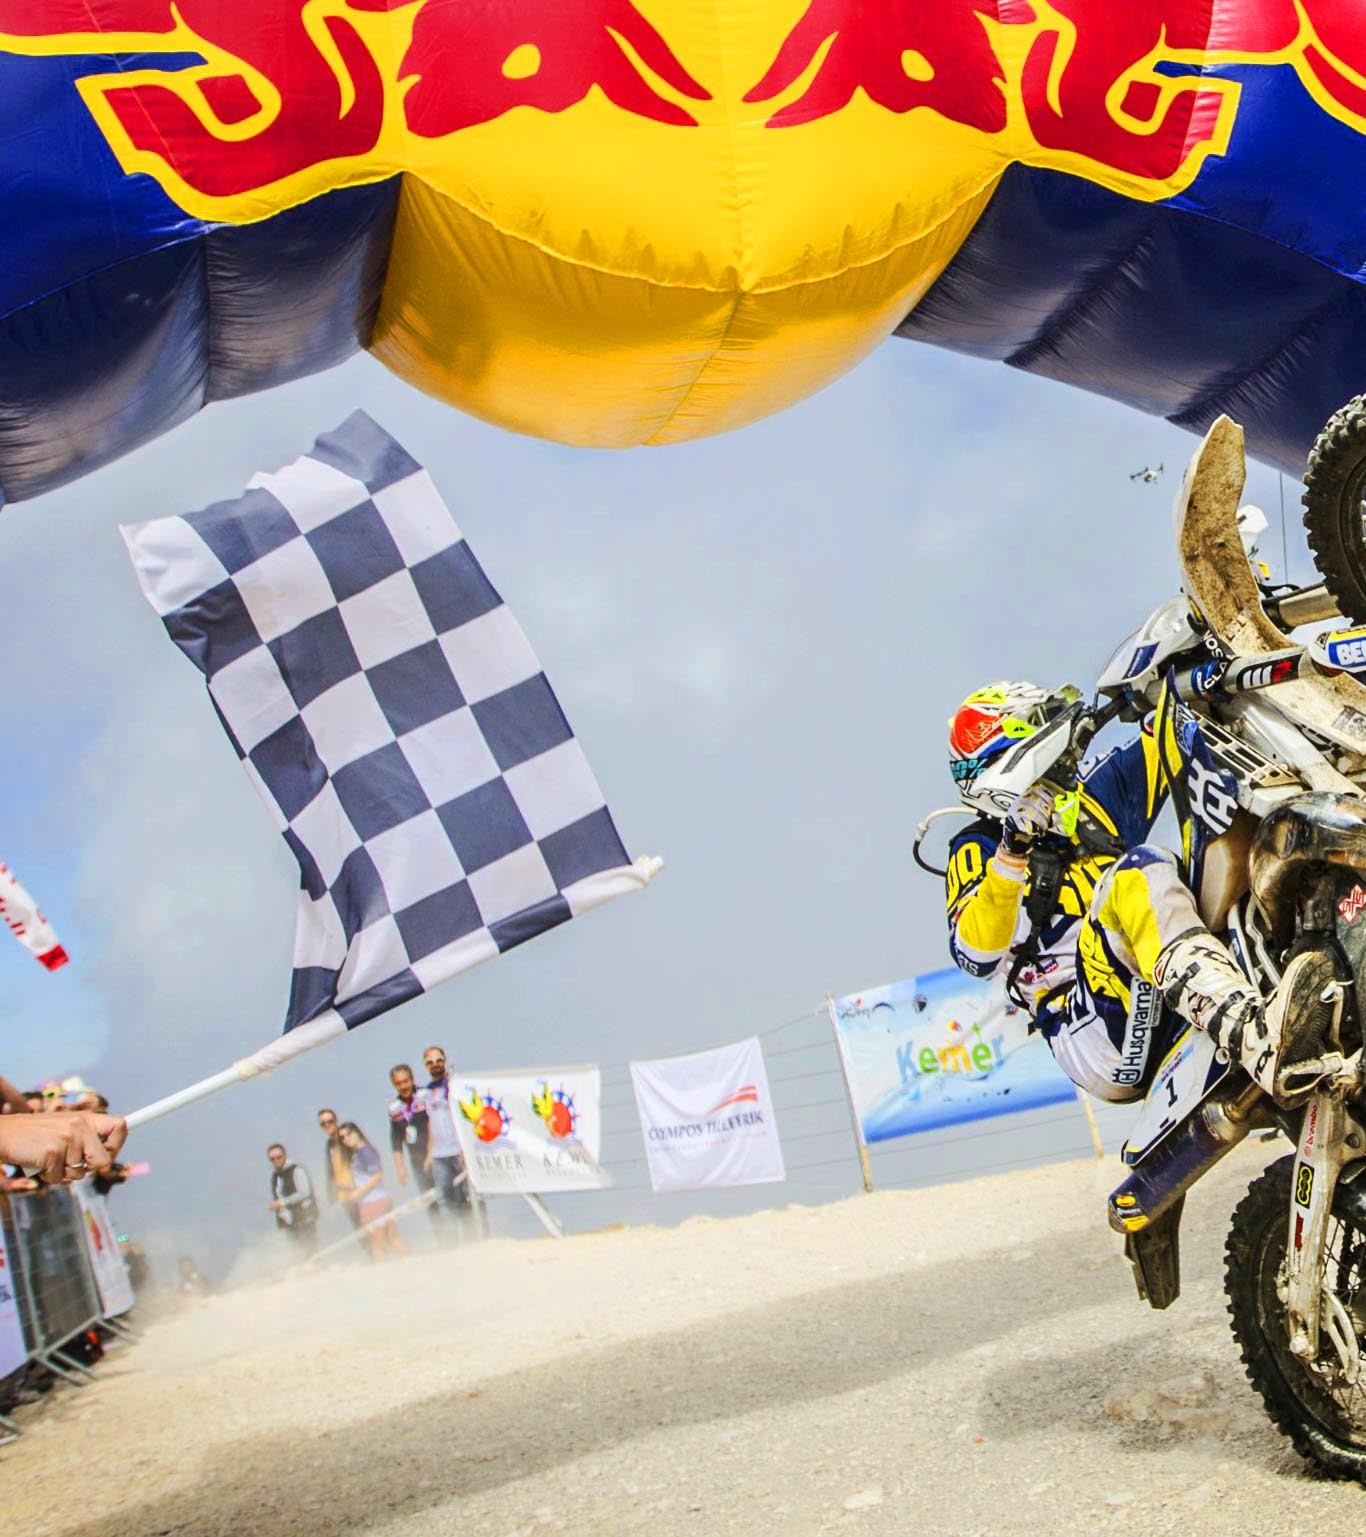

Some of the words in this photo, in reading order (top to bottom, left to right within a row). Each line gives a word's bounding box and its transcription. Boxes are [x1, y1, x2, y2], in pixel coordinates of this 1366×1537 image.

[1188, 945, 1240, 974] TCX
[1123, 981, 1152, 1067] Husqvarna
[896, 1034, 1004, 1084] Kemer
